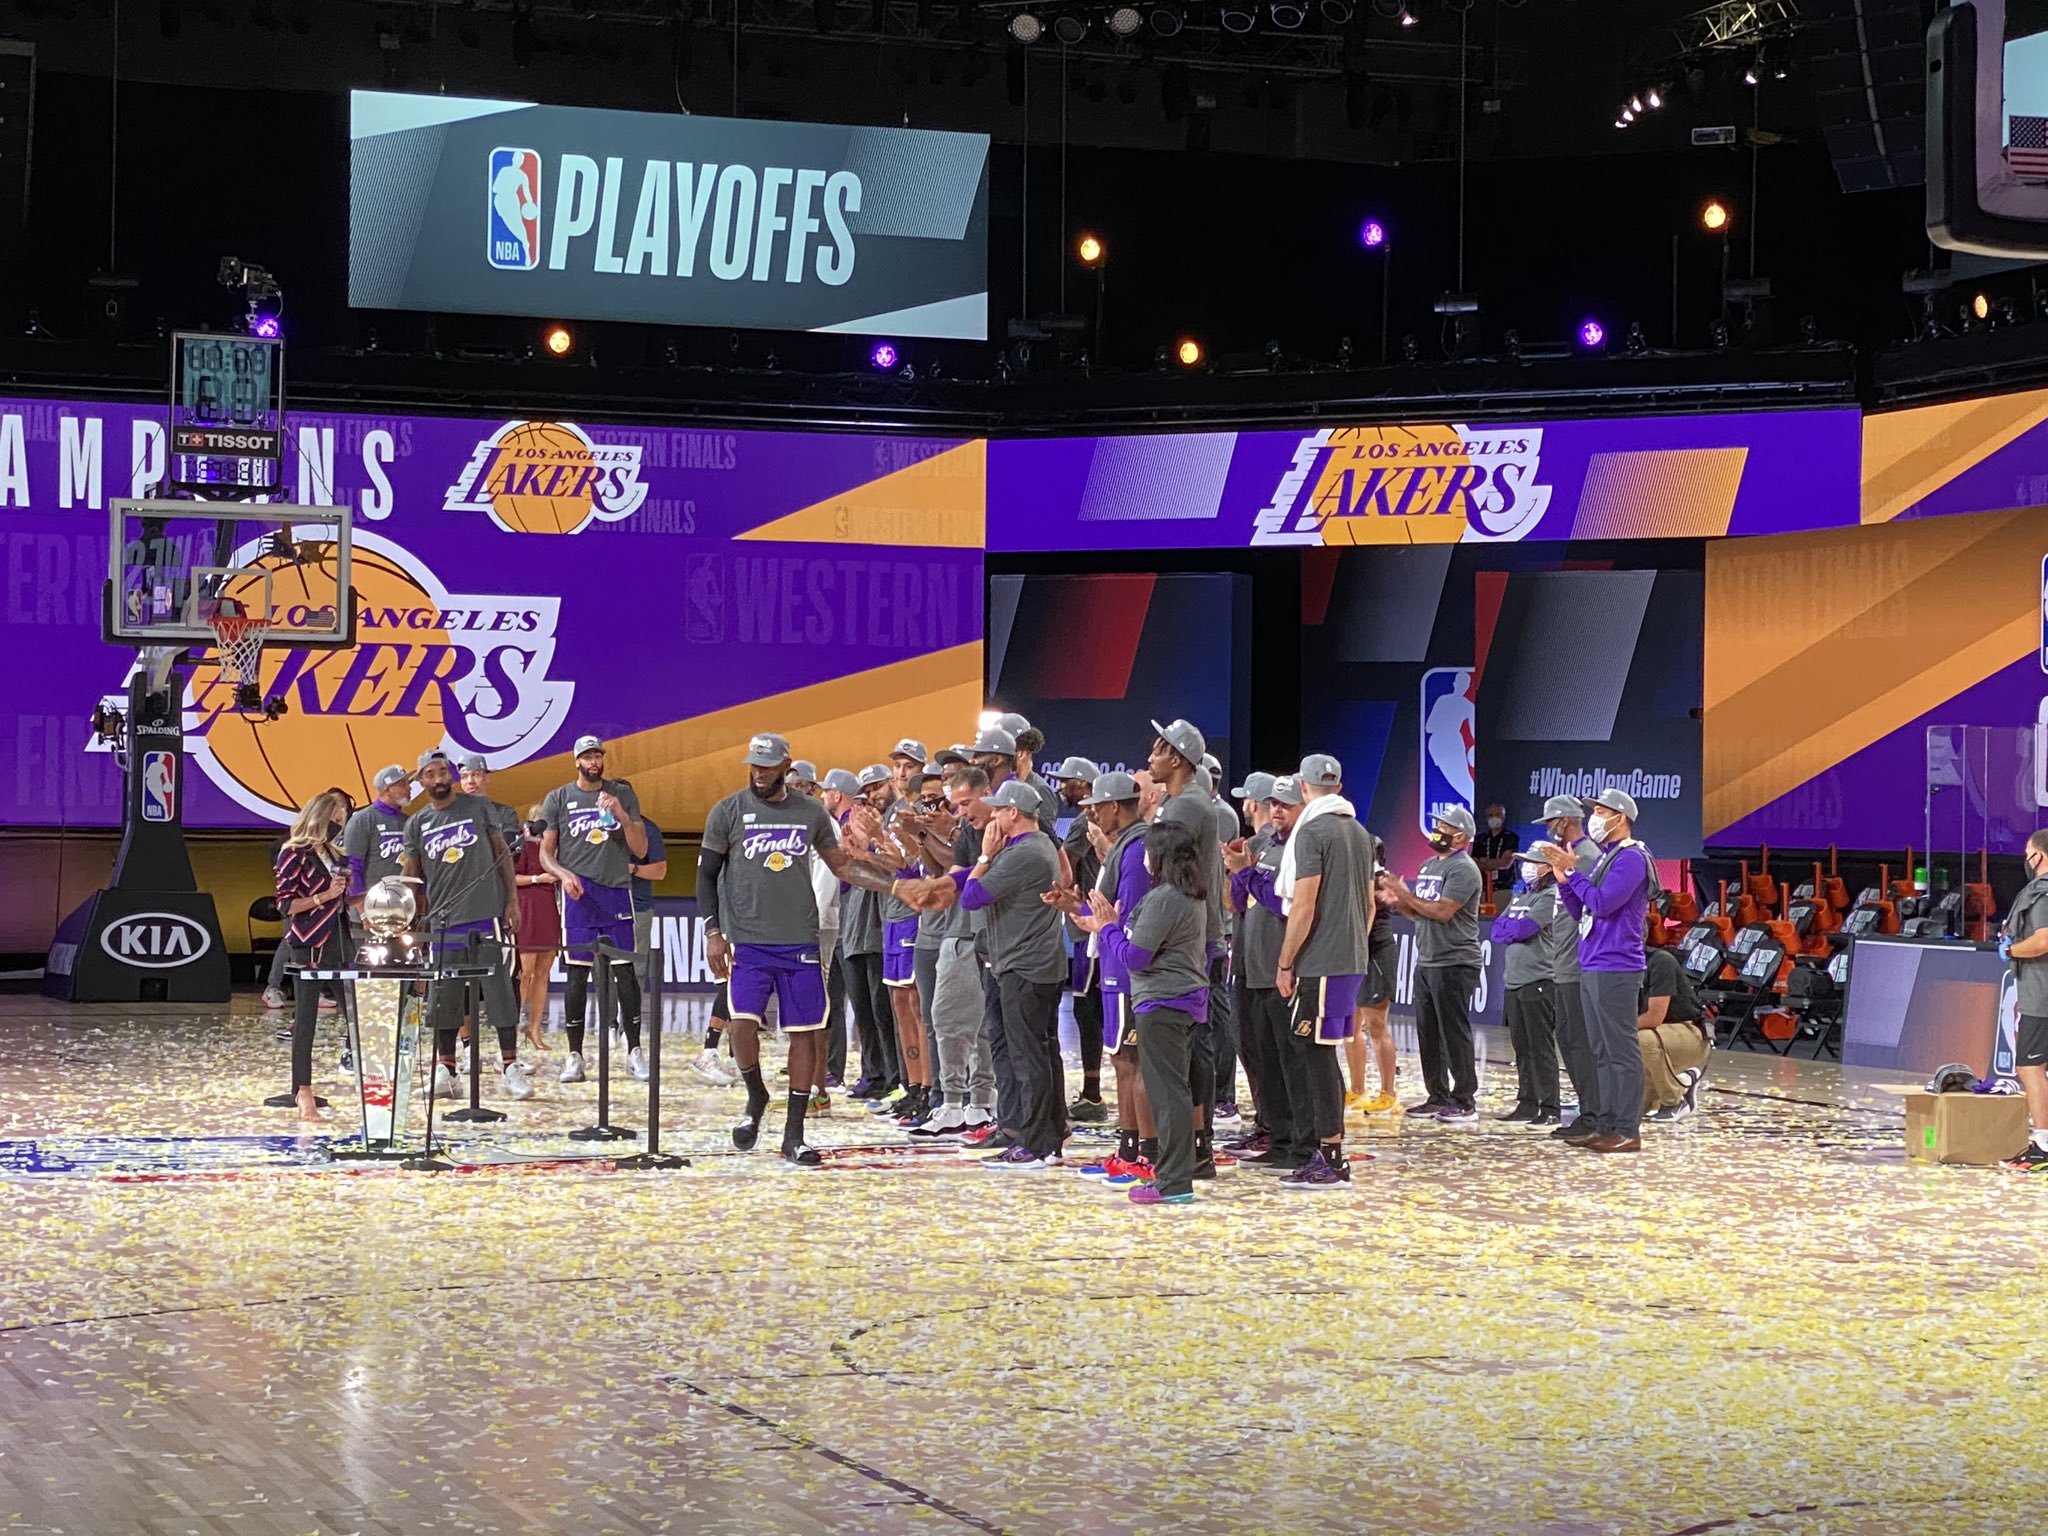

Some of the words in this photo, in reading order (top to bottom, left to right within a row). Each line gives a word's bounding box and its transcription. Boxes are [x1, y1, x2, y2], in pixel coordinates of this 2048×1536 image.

[548, 153, 863, 286] PLAYOFFS
[495, 241, 520, 261] NBA
[205, 433, 274, 450] TISSOT
[514, 447, 548, 460] LOS
[549, 449, 634, 463] ANGELES
[670, 432, 737, 470] FINALS
[1351, 443, 1401, 460] LOS
[1402, 438, 1530, 458] ANGELES
[453, 446, 640, 514] LAKERS
[1265, 441, 1539, 538] LAKERS
[734, 556, 958, 648] WESTERN
[357, 606, 542, 633] ANGELES
[136, 723, 181, 737] SPALDING
[1529, 767, 1683, 800] #WholeNewGame
[146, 804, 163, 817] NBA
[424, 824, 479, 860] Finals
[742, 829, 808, 860] Finals
[119, 924, 192, 956] KIA
